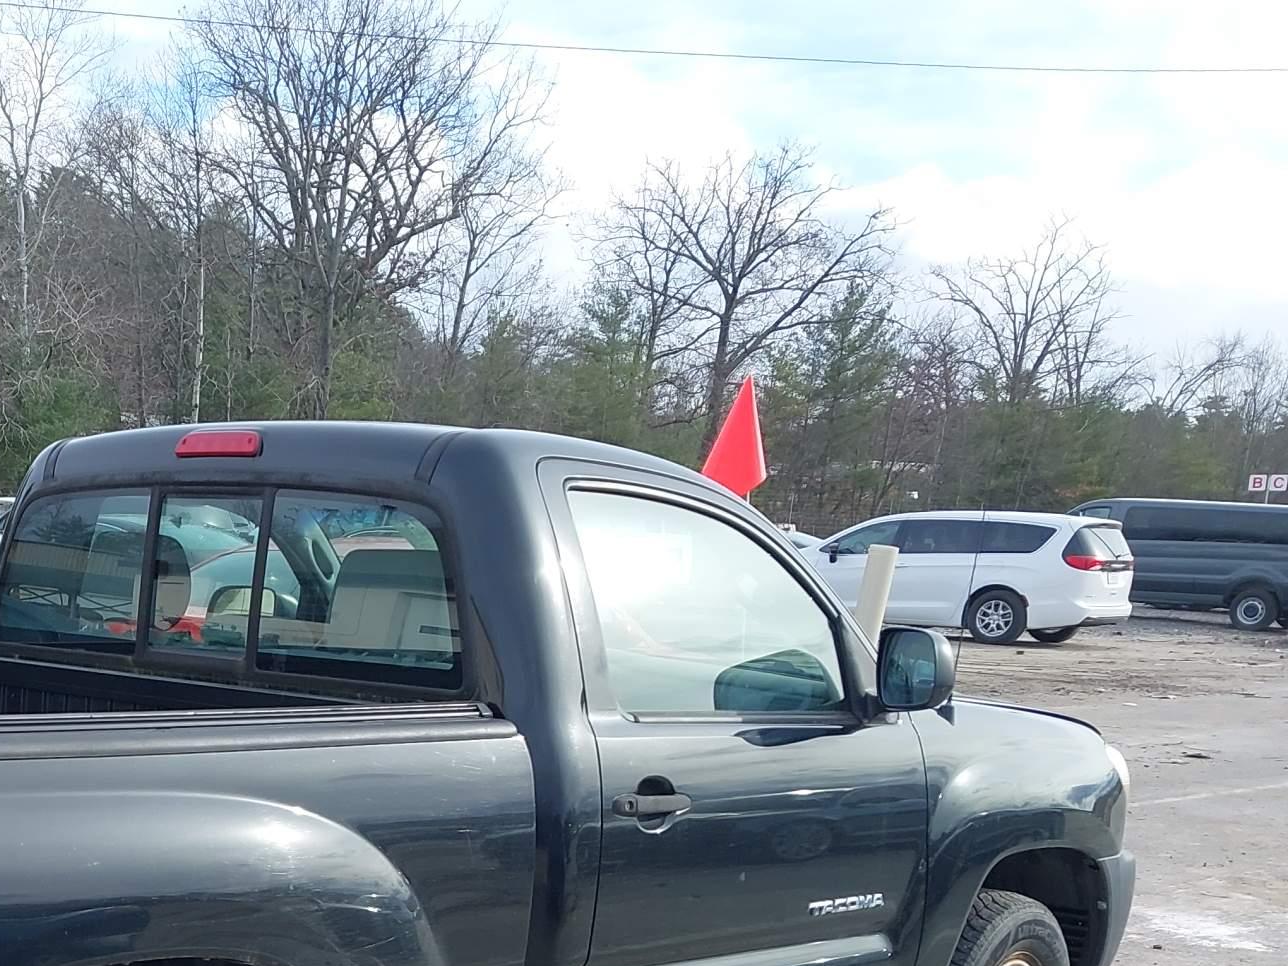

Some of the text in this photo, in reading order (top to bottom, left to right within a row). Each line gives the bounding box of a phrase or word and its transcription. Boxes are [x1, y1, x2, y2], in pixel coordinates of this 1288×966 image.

[1253, 477, 1263, 489] B
[1273, 477, 1285, 489] C
[808, 893, 885, 916] TACOMA
